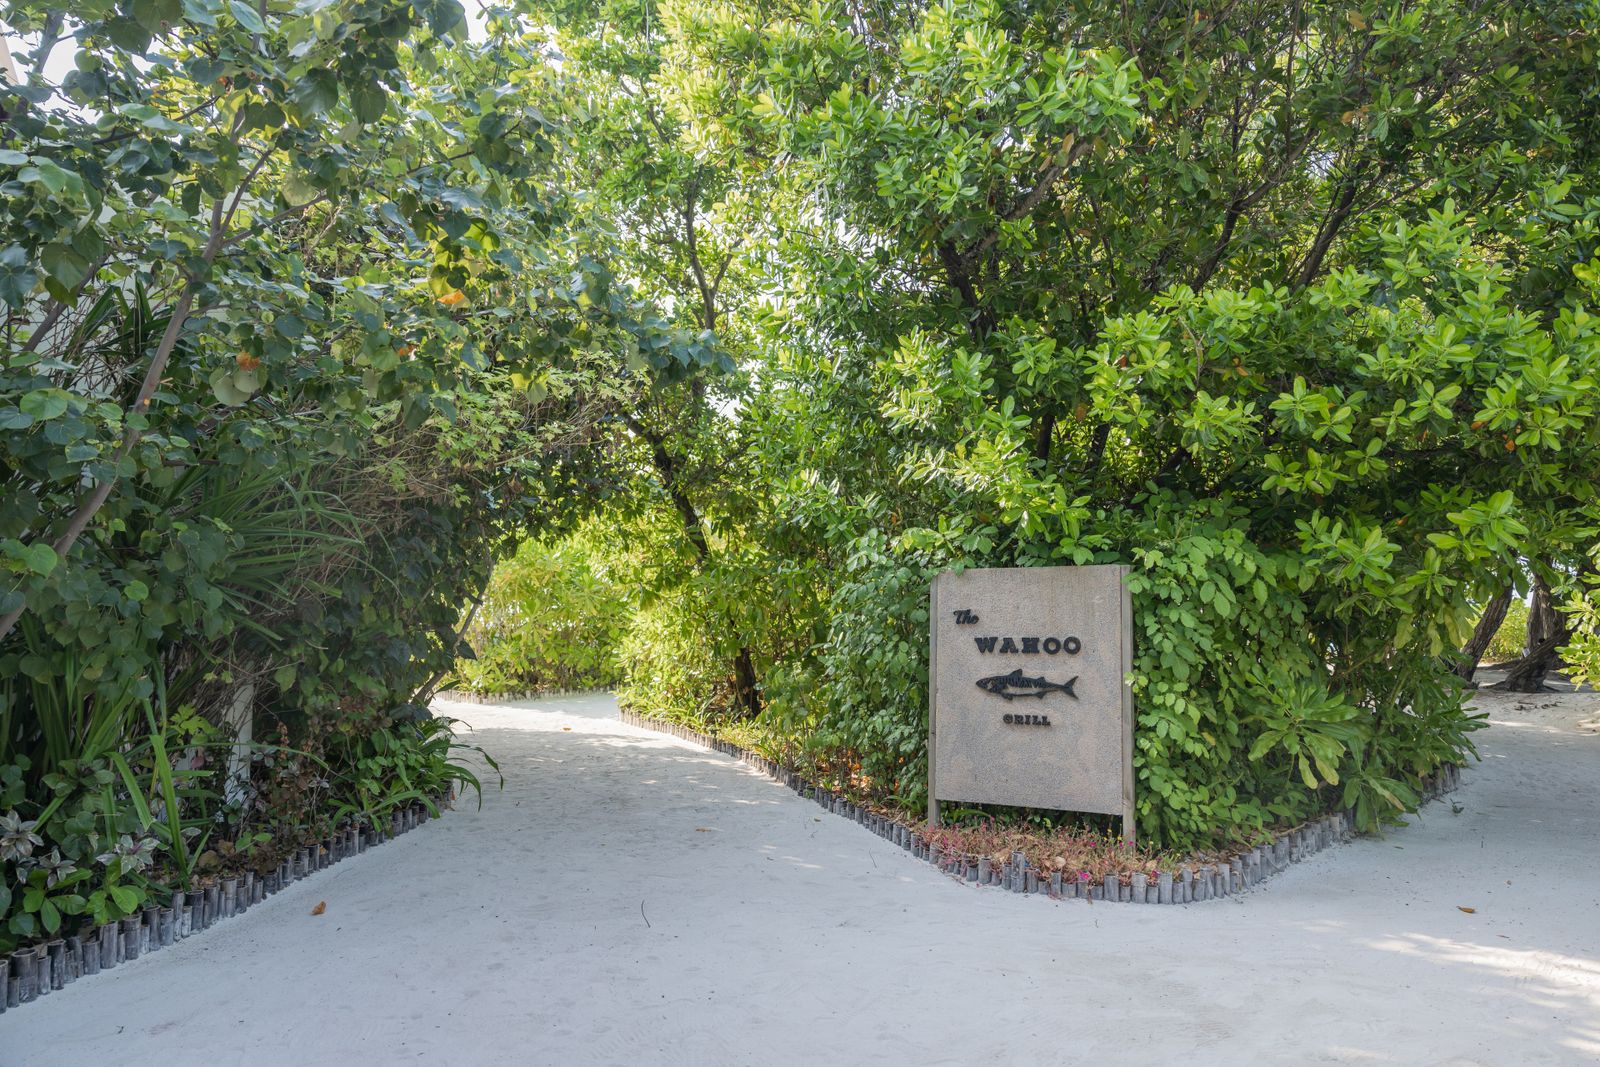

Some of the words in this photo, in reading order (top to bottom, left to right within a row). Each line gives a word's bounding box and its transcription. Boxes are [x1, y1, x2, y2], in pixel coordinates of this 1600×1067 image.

[953, 609, 979, 624] The
[974, 636, 1081, 655] WAHOO
[1003, 714, 1051, 726] GRILL
